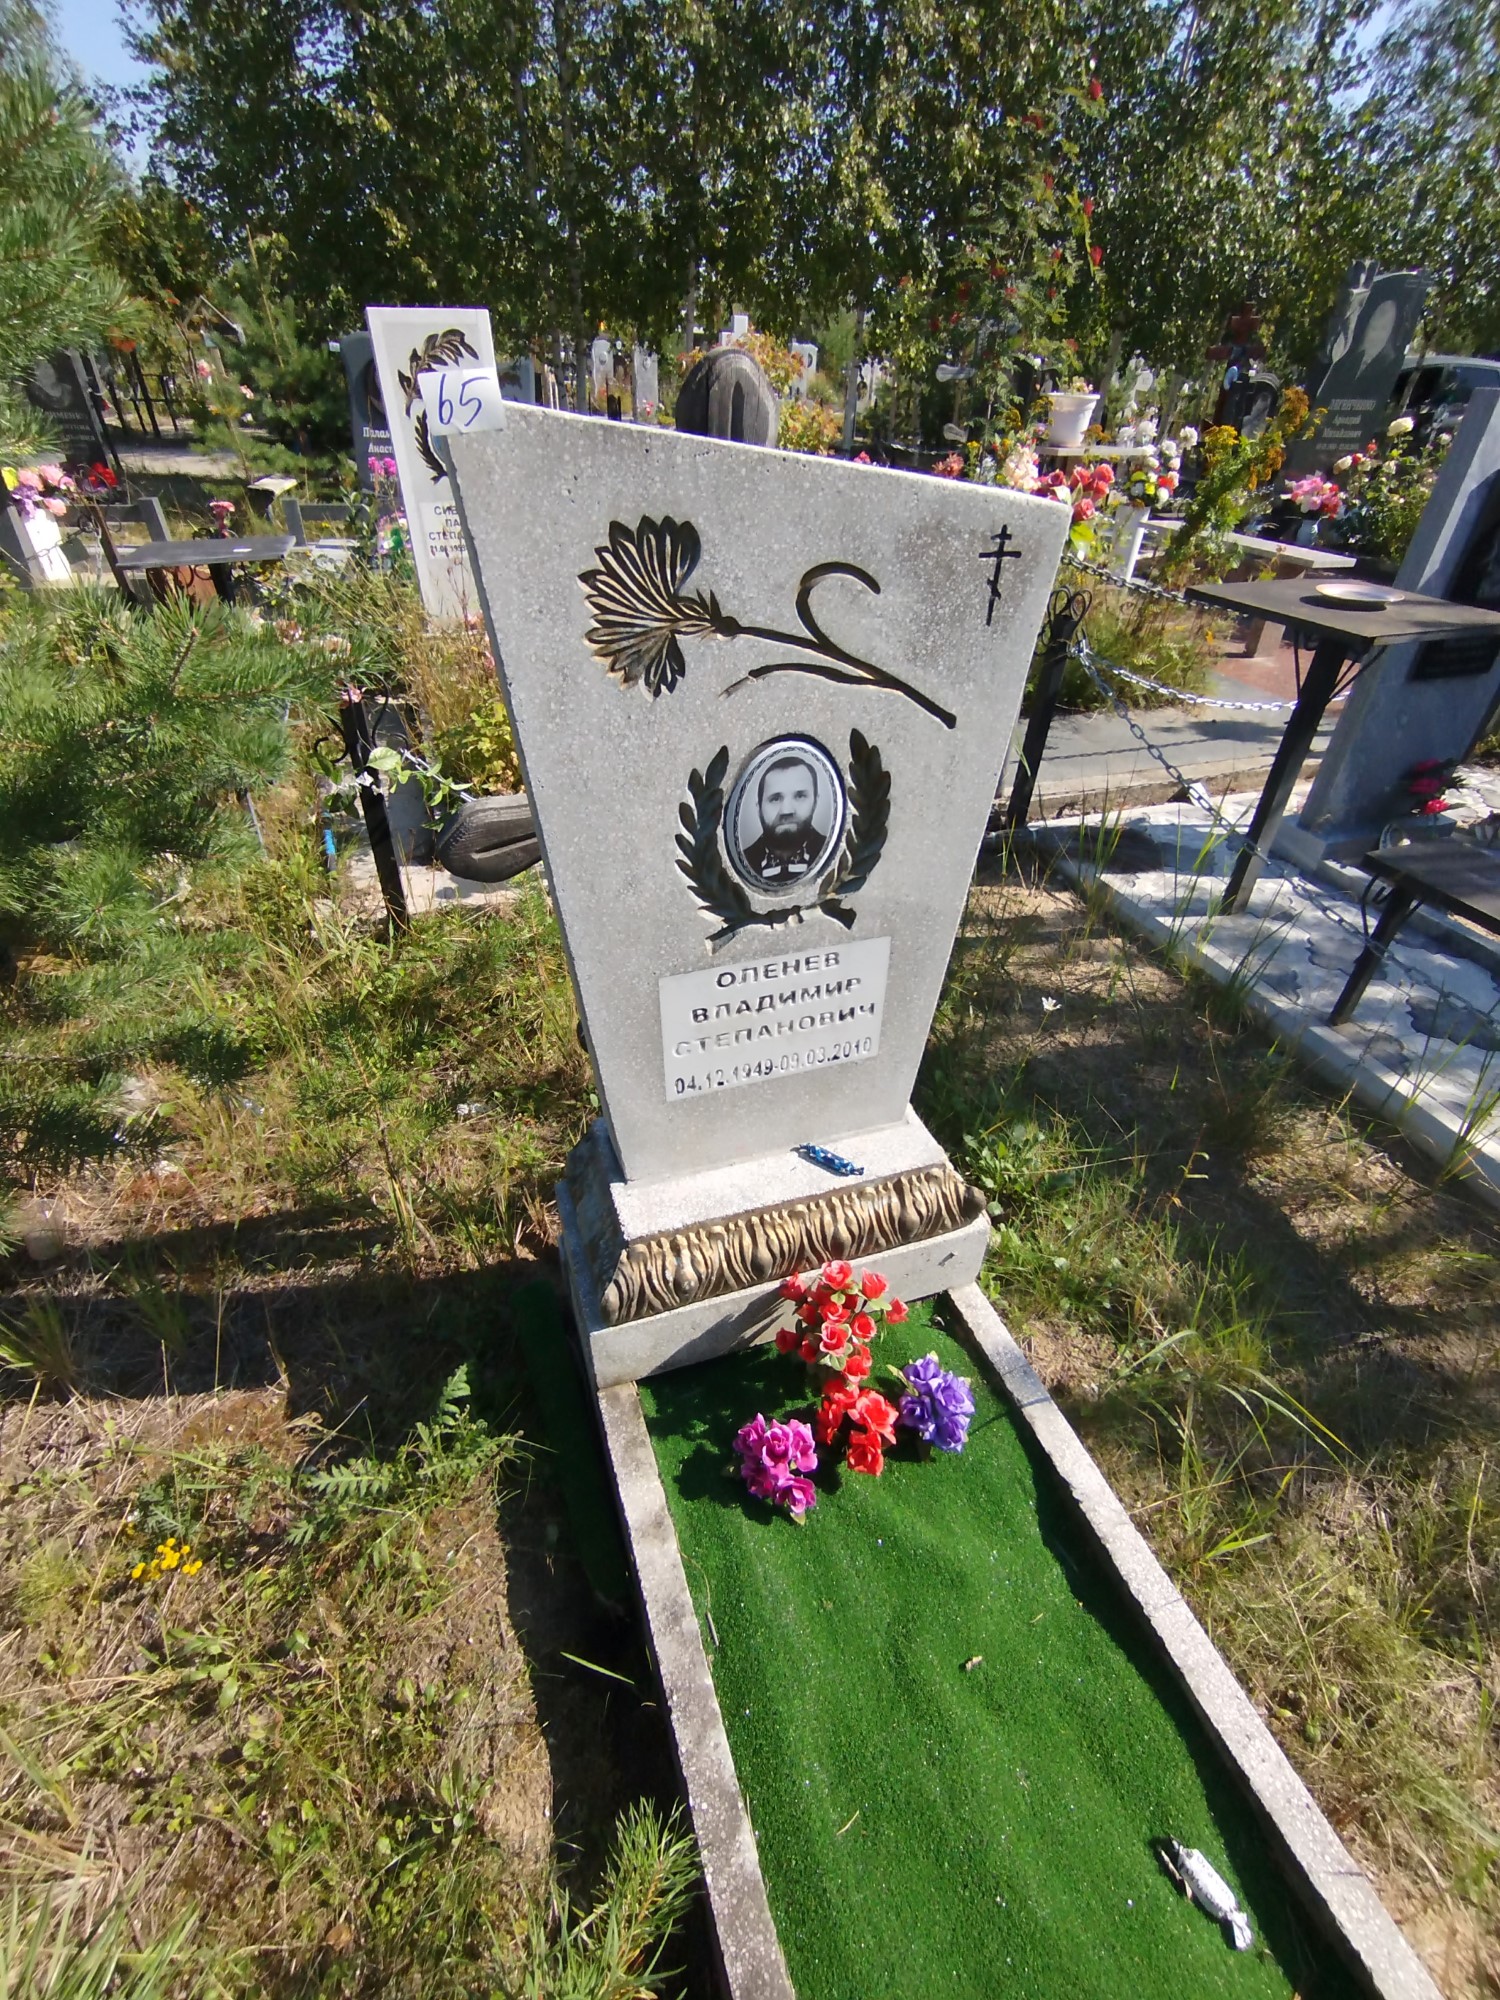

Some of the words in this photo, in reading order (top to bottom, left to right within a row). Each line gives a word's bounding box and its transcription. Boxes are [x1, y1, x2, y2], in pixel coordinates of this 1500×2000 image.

[438, 373, 490, 427] 65
[716, 952, 841, 988] ОЛЕНЕВ
[692, 977, 862, 1023] ВЛАДИМИР
[674, 1003, 876, 1056] СТЕПАНОВИЧ
